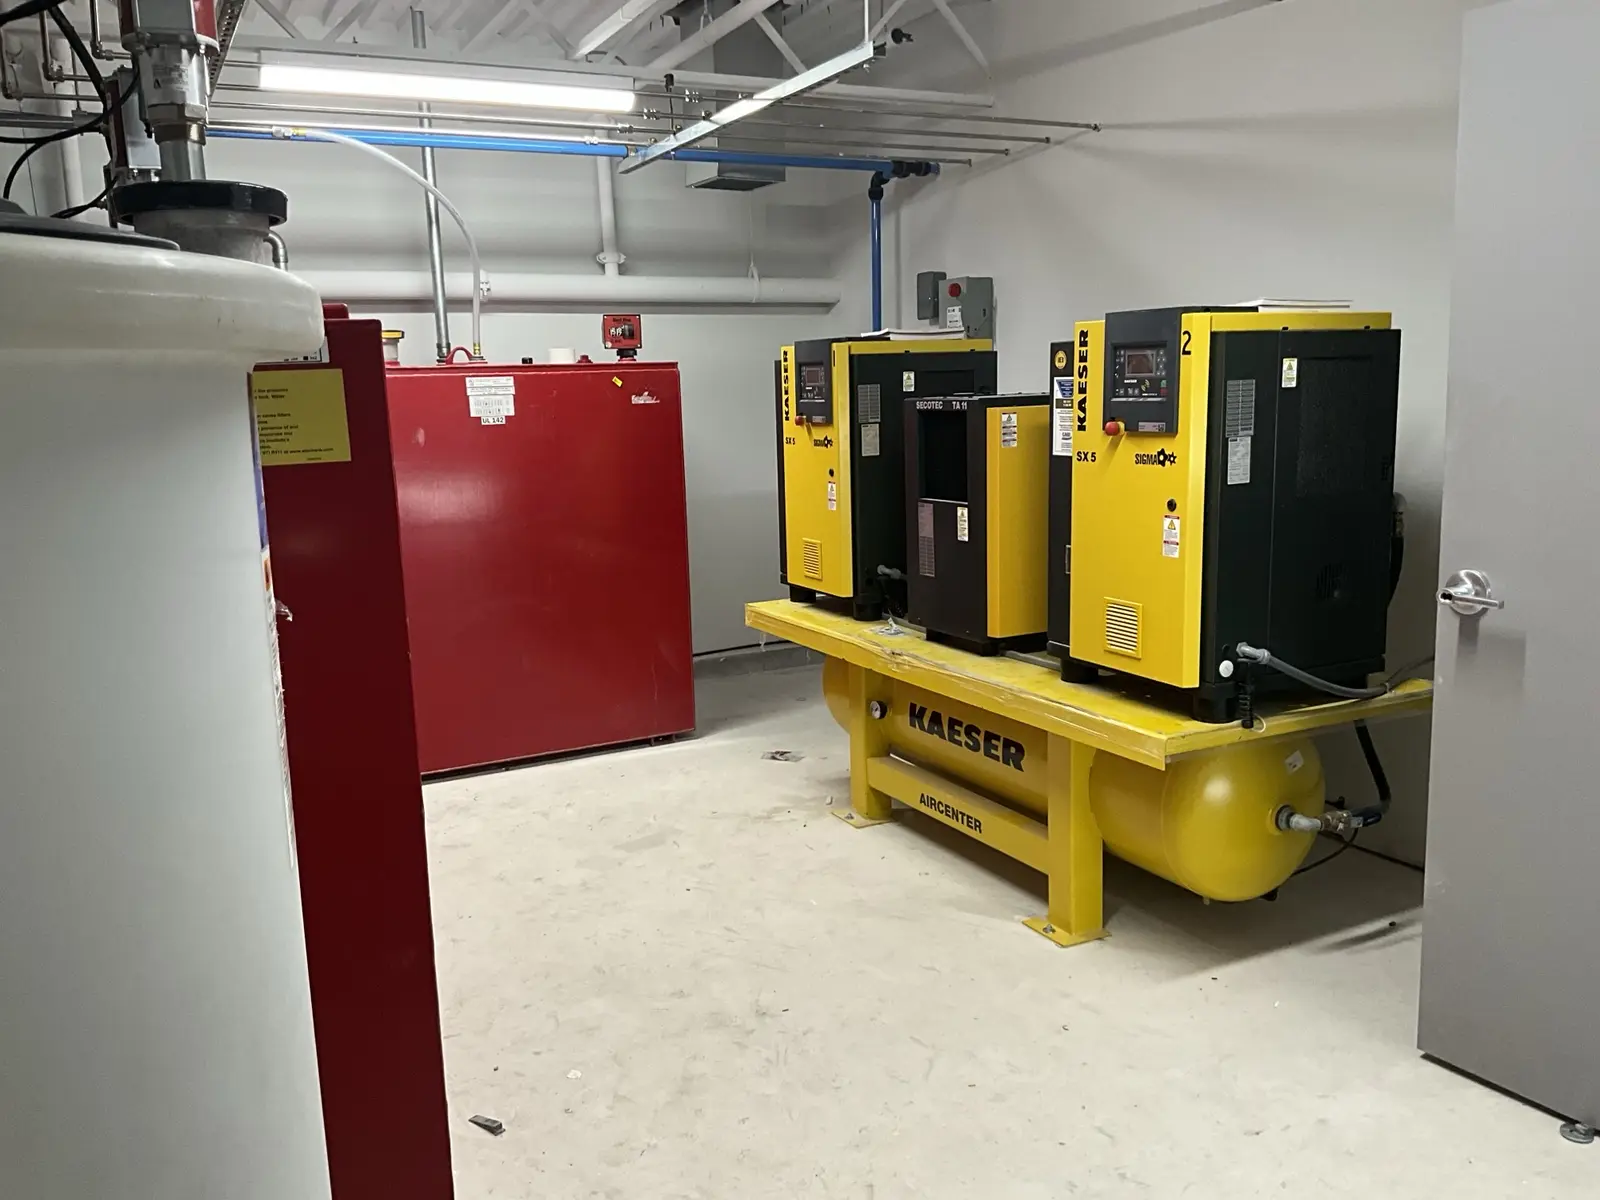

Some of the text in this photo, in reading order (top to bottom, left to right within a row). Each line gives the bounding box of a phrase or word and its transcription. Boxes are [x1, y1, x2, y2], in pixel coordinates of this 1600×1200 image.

[1181, 330, 1191, 355] 2
[1077, 329, 1088, 431] KAESER
[916, 401, 968, 410] SECOTEC TA 11
[492, 416, 504, 424] 142
[785, 437, 792, 445] SX
[1076, 451, 1097, 462] SX 5
[1134, 453, 1159, 465] SIGMA
[909, 702, 1025, 772] KAESER
[920, 793, 982, 834] AIRCENTER
